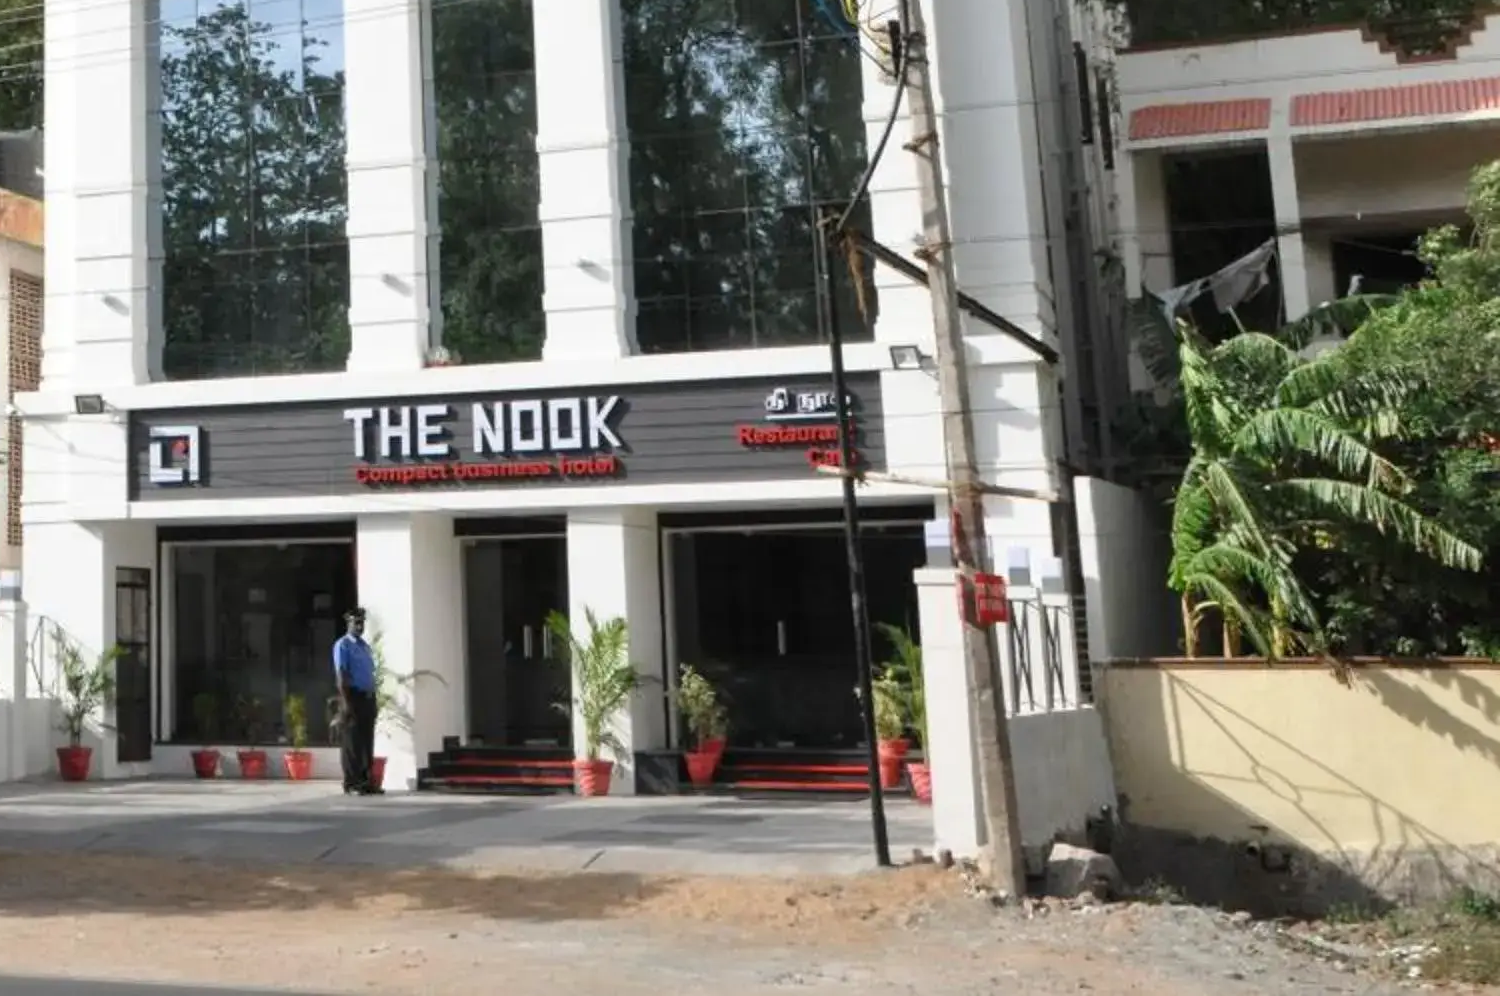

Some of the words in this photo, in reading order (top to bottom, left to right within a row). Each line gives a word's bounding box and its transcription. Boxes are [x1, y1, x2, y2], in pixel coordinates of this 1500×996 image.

[343, 404, 450, 457] THE
[471, 395, 622, 453] NOOK
[737, 422, 856, 443] Restauran
[453, 460, 550, 479] business
[557, 454, 616, 476] hotel
